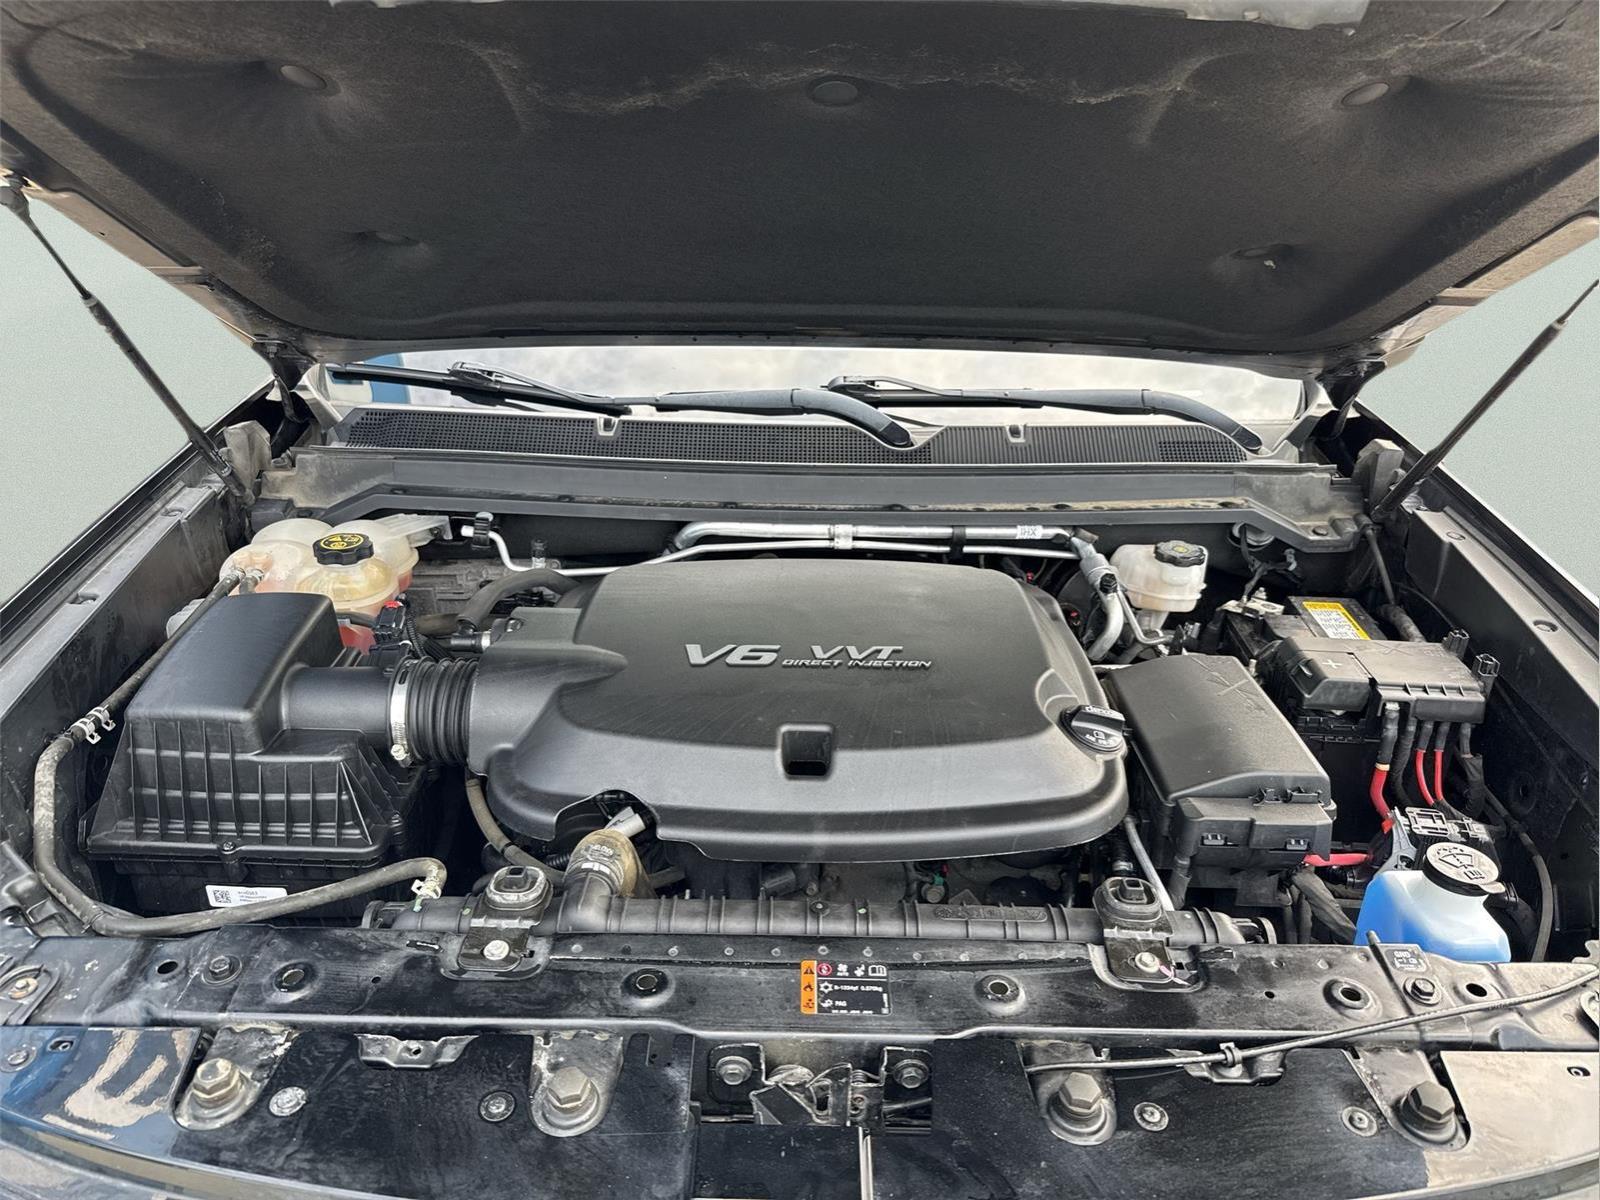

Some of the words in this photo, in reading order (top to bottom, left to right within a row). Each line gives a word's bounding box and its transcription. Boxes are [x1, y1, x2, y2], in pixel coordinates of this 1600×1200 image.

[685, 644, 781, 666] V6
[810, 645, 903, 660] VVT
[782, 659, 843, 668] DIRECT
[848, 659, 932, 668] INJECTION
